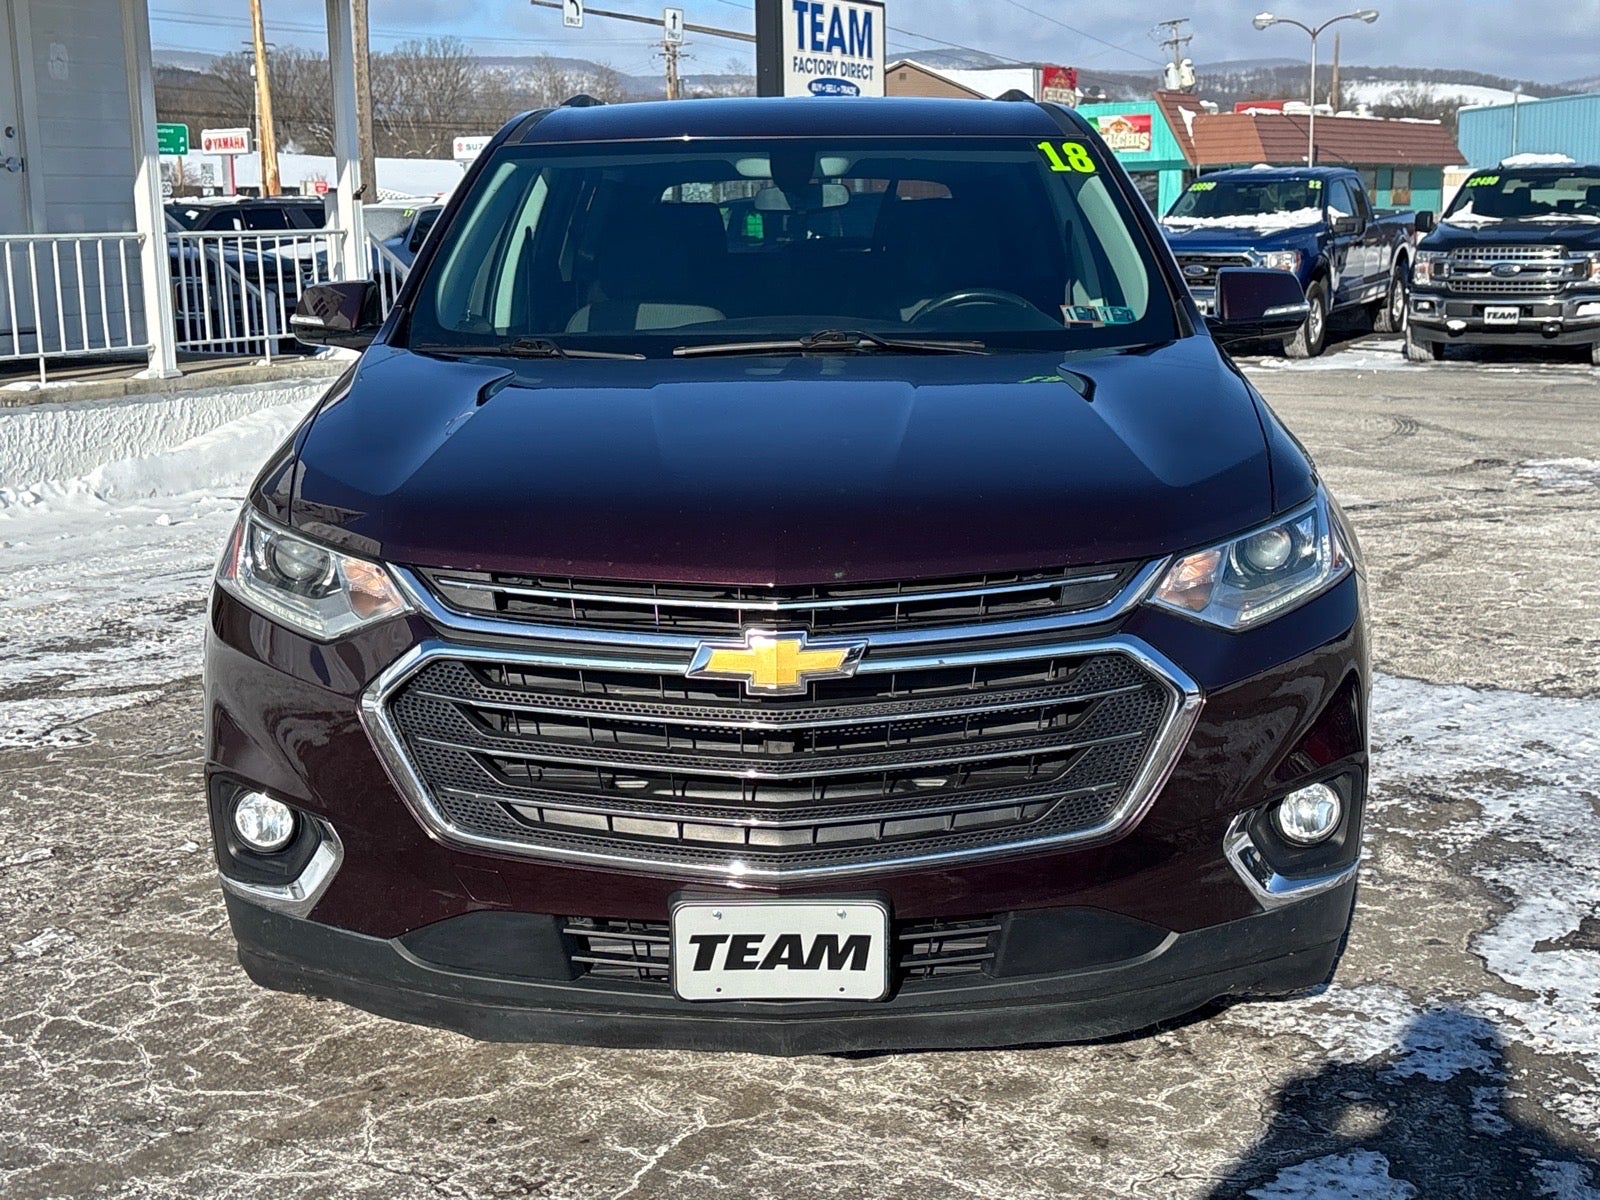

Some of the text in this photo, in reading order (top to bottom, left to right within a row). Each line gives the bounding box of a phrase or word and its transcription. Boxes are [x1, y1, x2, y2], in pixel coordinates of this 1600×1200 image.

[565, 16, 580, 25] ONLY
[667, 31, 681, 40] ONLY
[793, 0, 873, 59] TEAM
[793, 56, 874, 80] FACTORY DIRECT
[825, 84, 837, 93] SELL
[212, 137, 245, 151] YAMAHA
[1037, 141, 1096, 173] 18
[1486, 311, 1518, 320] TEAM
[689, 934, 872, 971] TEAM
